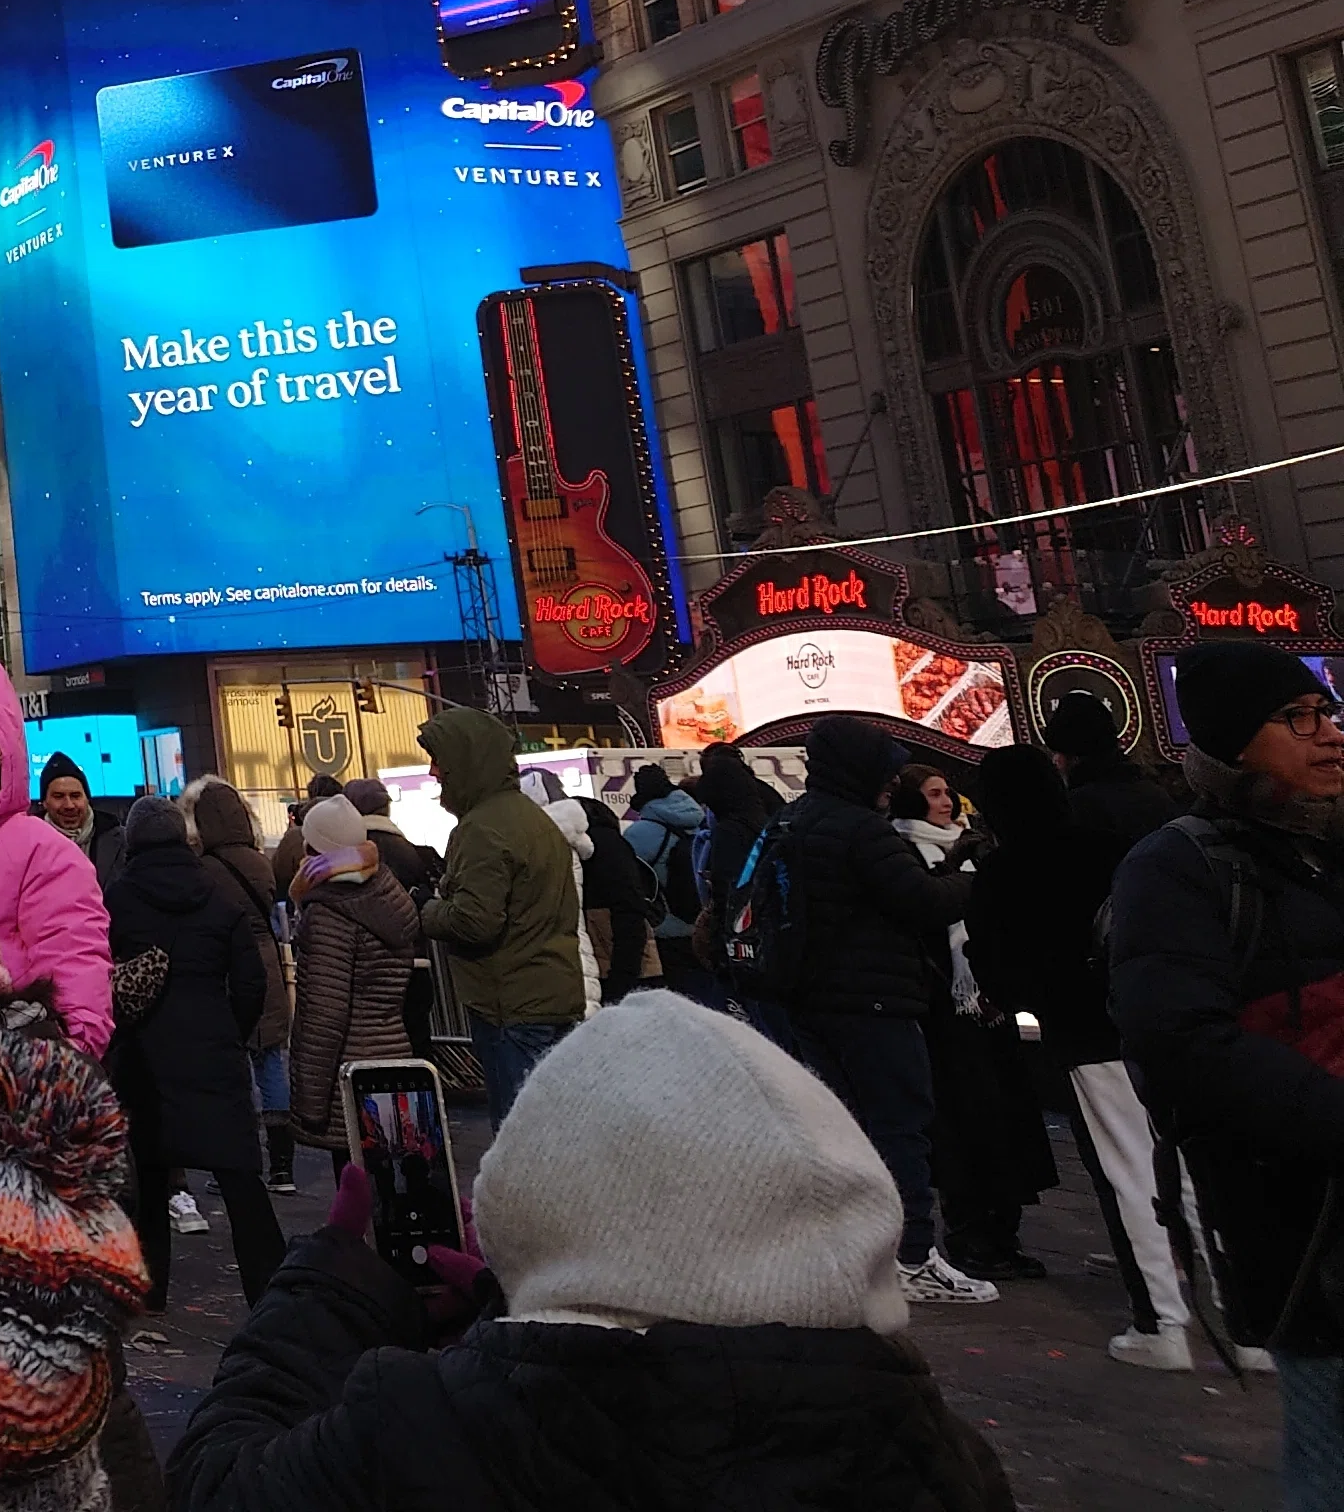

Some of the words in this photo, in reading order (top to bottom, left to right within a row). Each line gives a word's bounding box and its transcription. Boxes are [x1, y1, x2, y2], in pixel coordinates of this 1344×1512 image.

[127, 147, 218, 173] VENTURE
[222, 145, 235, 159] X
[453, 166, 579, 188] VENTURE
[584, 170, 602, 189] X
[5, 226, 55, 265] VENTURE
[55, 222, 64, 238] X
[120, 328, 231, 371] Make
[238, 318, 318, 358] this
[325, 310, 398, 350] the
[127, 383, 218, 428] year
[227, 367, 270, 408] of
[275, 355, 402, 404] travel
[141, 591, 182, 607] Terms
[184, 587, 224, 607] apply.
[226, 586, 252, 602] See
[254, 580, 359, 602] capitalone.com
[361, 578, 383, 593] for
[385, 575, 438, 592] details.
[757, 576, 810, 616] Hard
[811, 569, 867, 614] Rock
[536, 596, 590, 622] Hard
[594, 594, 651, 624] Rock
[1246, 601, 1300, 632] Rock
[787, 653, 810, 670] Hard
[811, 650, 836, 670] Rock
